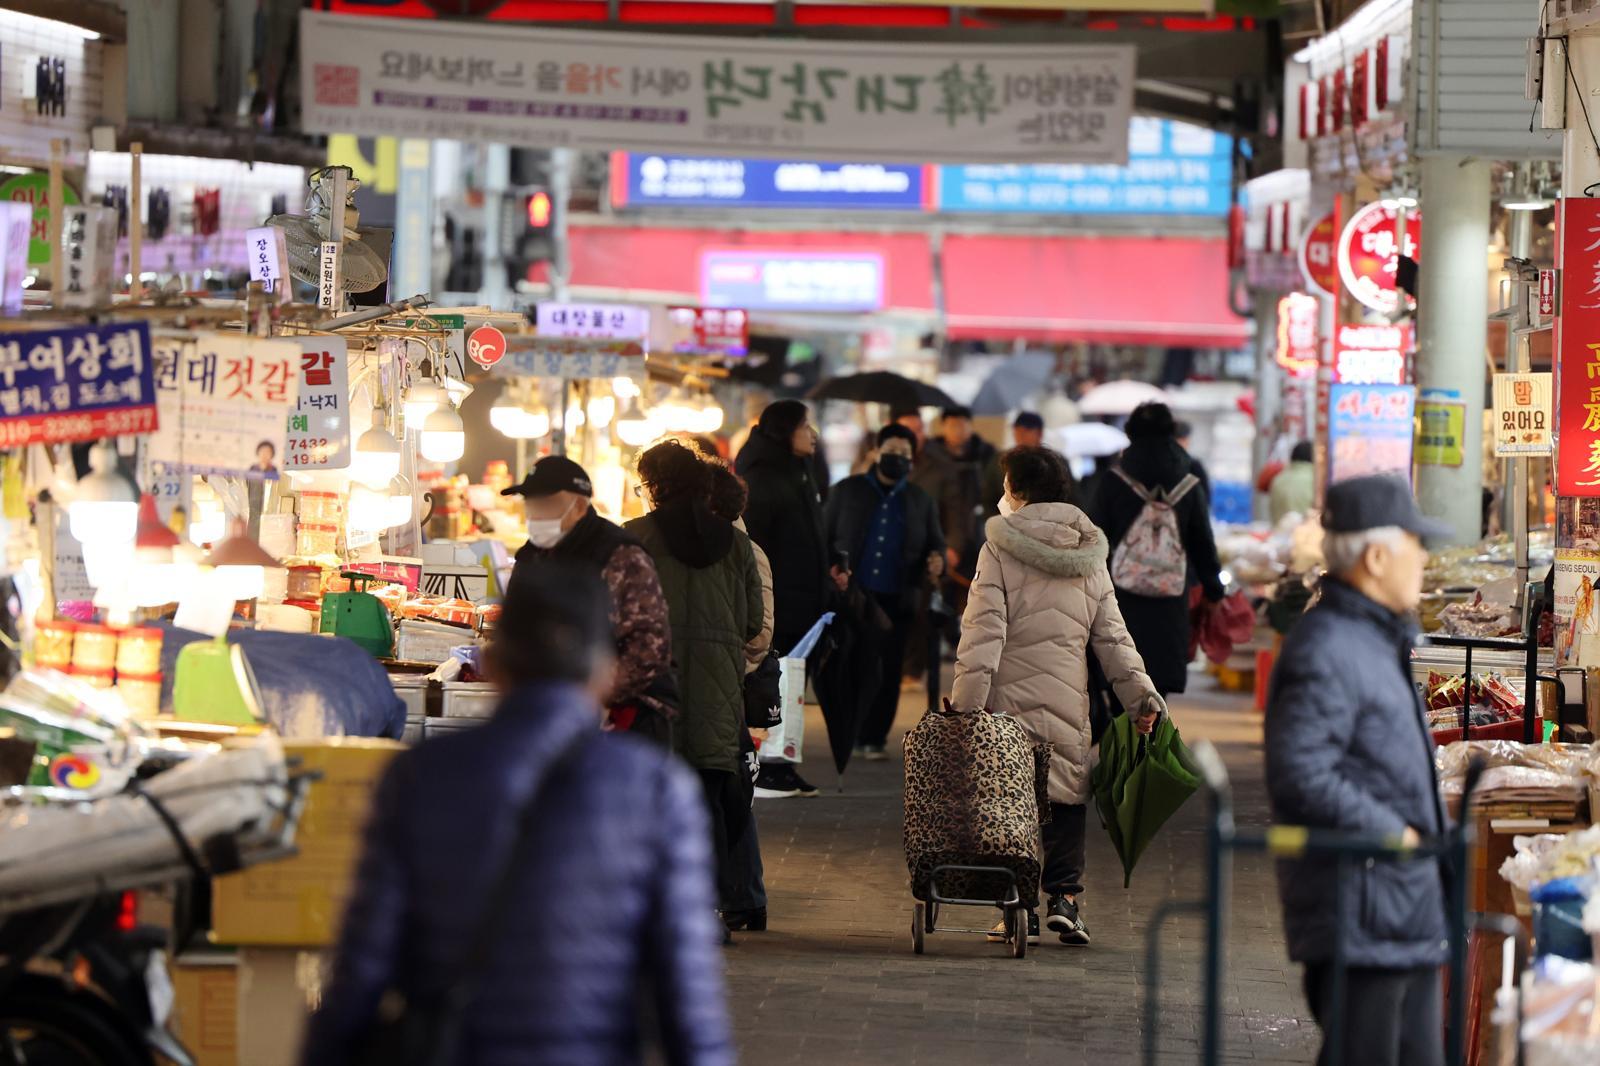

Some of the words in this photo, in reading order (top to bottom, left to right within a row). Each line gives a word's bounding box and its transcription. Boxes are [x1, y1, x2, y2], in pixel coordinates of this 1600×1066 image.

[322, 257, 333, 308] 근원상회
[467, 339, 497, 366] BC
[1513, 381, 1532, 406] 밤
[1502, 410, 1545, 430] 있어요
[1573, 564, 1598, 574] SEOUL
